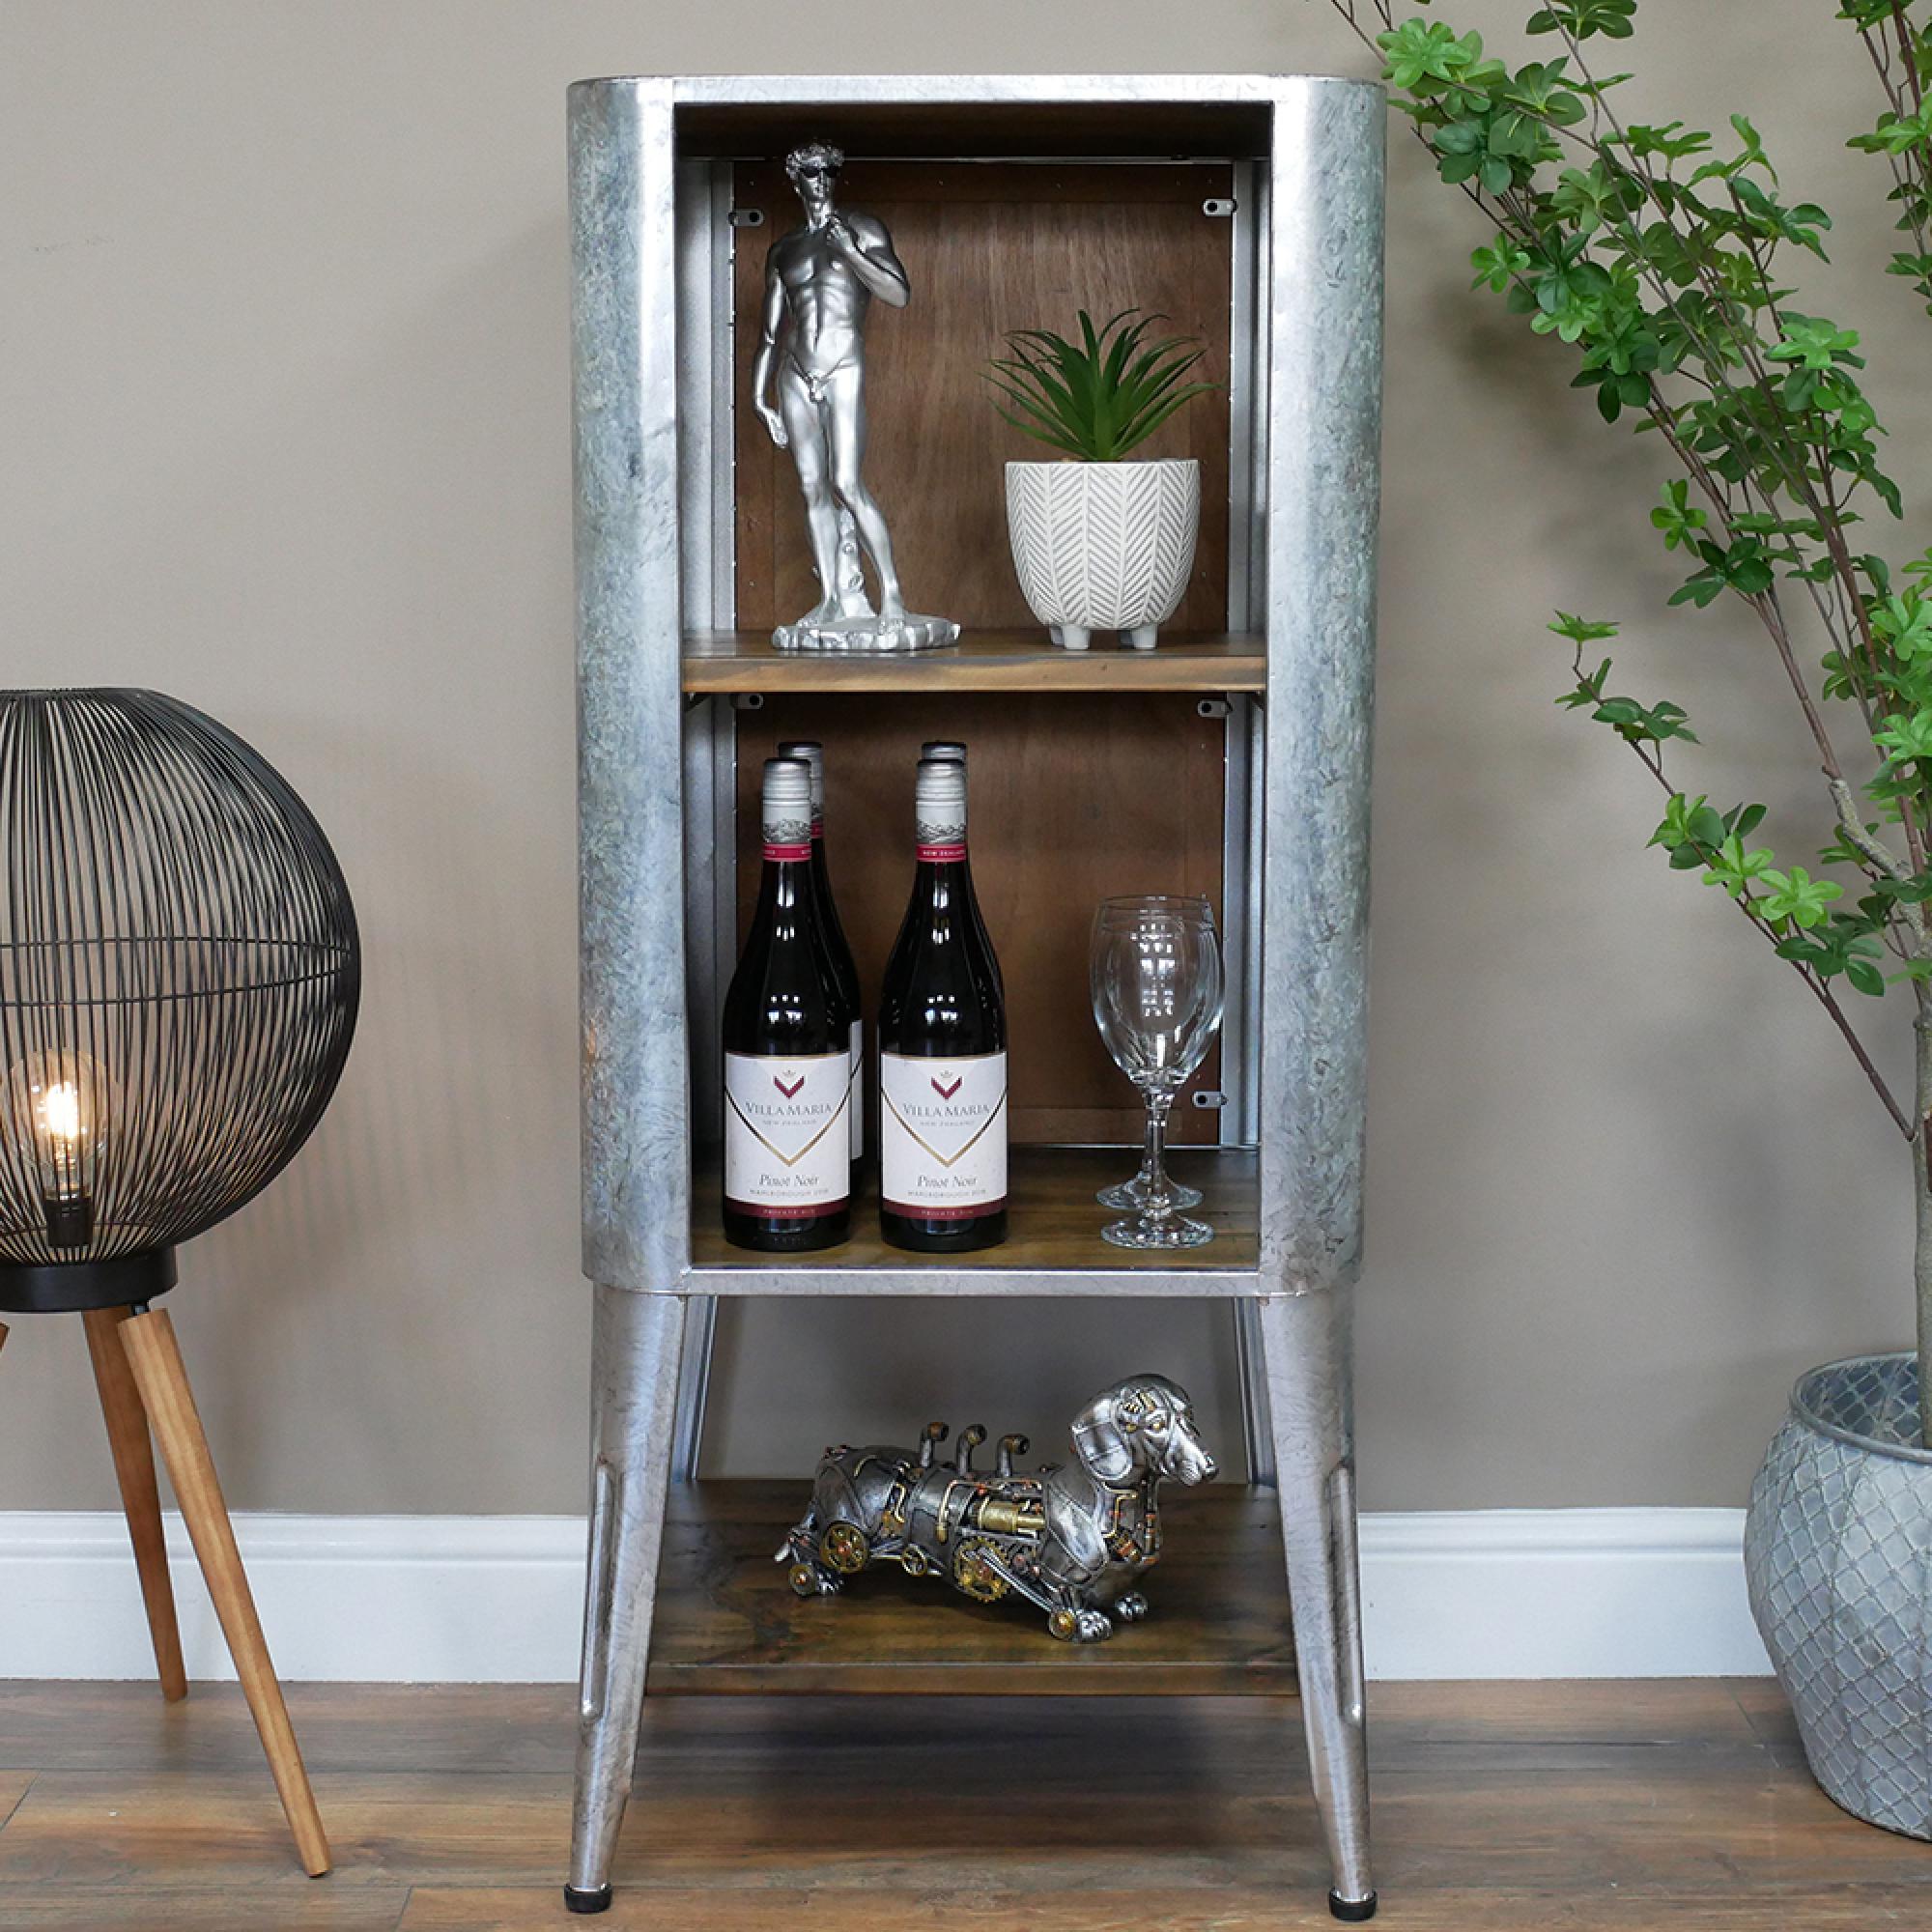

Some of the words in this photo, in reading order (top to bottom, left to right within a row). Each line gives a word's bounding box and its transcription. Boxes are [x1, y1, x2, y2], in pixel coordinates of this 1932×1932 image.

[745, 1102, 785, 1116] VILLA
[786, 1103, 832, 1116] MARIA
[903, 1102, 942, 1117] VILLA
[943, 1103, 989, 1116] MARIA
[758, 1174, 790, 1187] Pinot
[793, 1174, 819, 1187] Noir
[917, 1175, 949, 1188] Pinot
[952, 1175, 978, 1187] Noir
